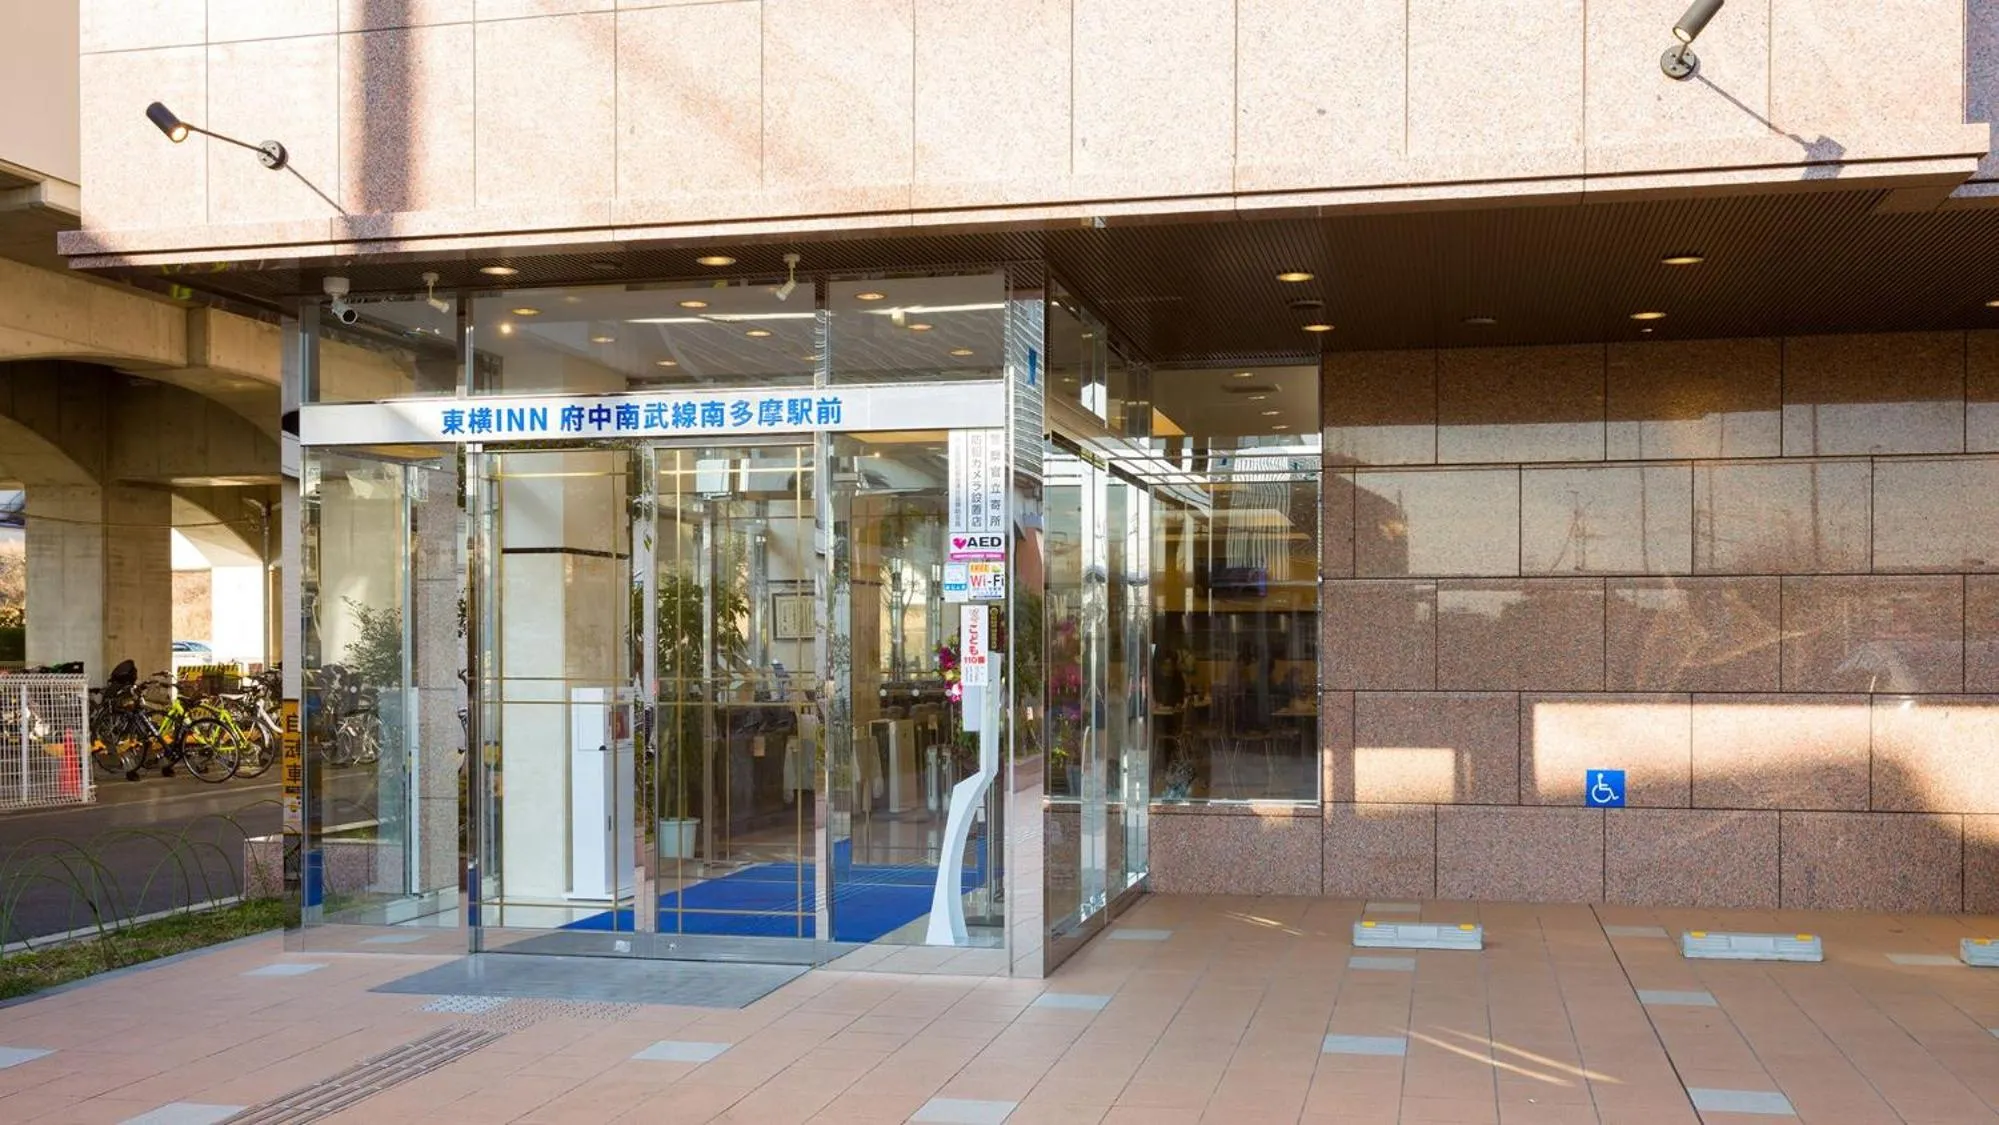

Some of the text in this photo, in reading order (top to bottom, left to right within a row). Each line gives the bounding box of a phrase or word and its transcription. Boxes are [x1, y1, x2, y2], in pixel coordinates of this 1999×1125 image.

[441, 396, 843, 435] 東横INN 府中南武線南多摩駅前
[967, 536, 1002, 548] AED
[970, 574, 1005, 587] Wi-Fi
